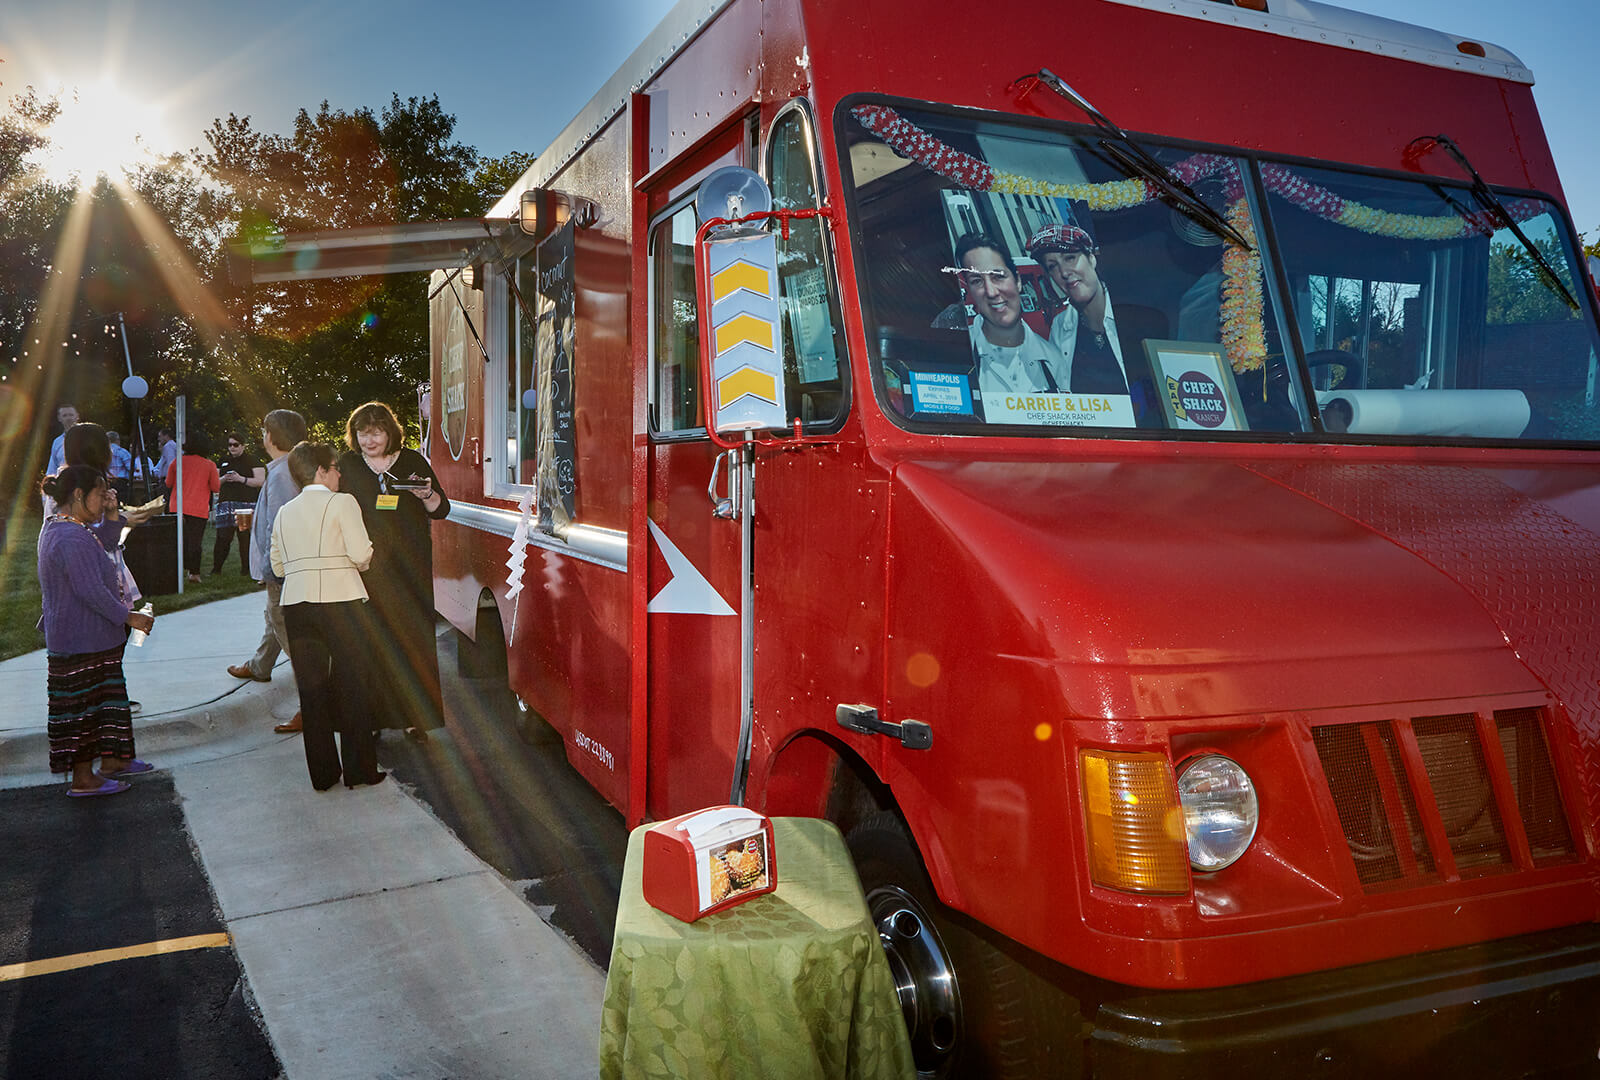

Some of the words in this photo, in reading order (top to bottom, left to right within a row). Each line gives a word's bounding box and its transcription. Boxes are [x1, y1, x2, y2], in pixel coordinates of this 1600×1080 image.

[915, 373, 960, 384] MINNEAPOLIS
[1182, 381, 1216, 395] CHEF
[1168, 382, 1180, 410] EAT
[1005, 396, 1061, 411] CARRIE
[1065, 398, 1076, 411] &
[1080, 398, 1113, 412] LISA
[1183, 398, 1224, 412] SHACK
[1026, 412, 1046, 420] CHEF
[1048, 413, 1071, 421] SHACK
[1072, 413, 1096, 421] RANCH
[1195, 413, 1221, 422] RANCH
